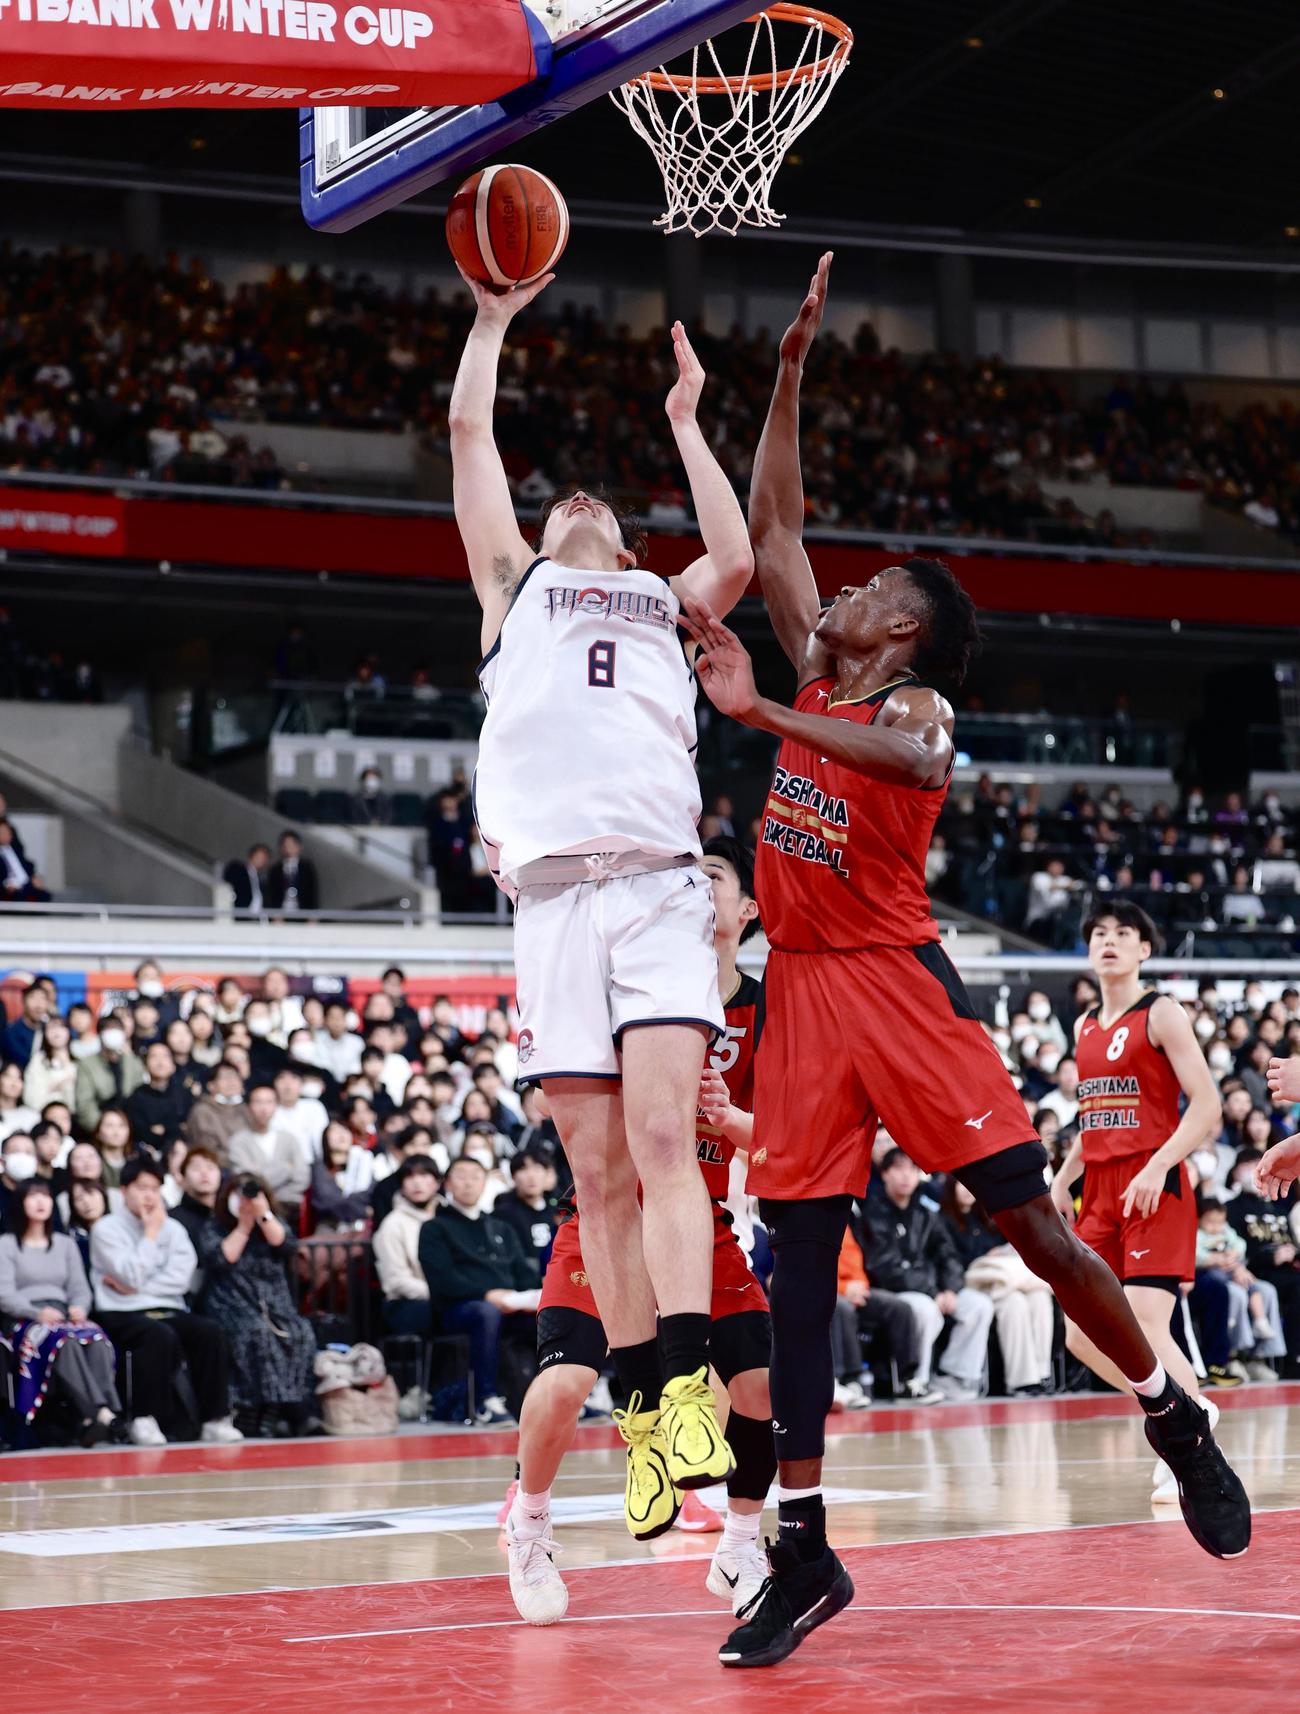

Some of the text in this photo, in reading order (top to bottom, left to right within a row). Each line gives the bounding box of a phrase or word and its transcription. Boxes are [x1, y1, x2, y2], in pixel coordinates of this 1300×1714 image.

[168, 0, 336, 42] WINTER
[344, 5, 433, 49] CUP
[0, 80, 400, 101] BANK WINTER CUP
[501, 195, 517, 250] molten
[588, 639, 616, 688] 8
[709, 1026, 747, 1072] 5
[1106, 1026, 1129, 1061] 8
